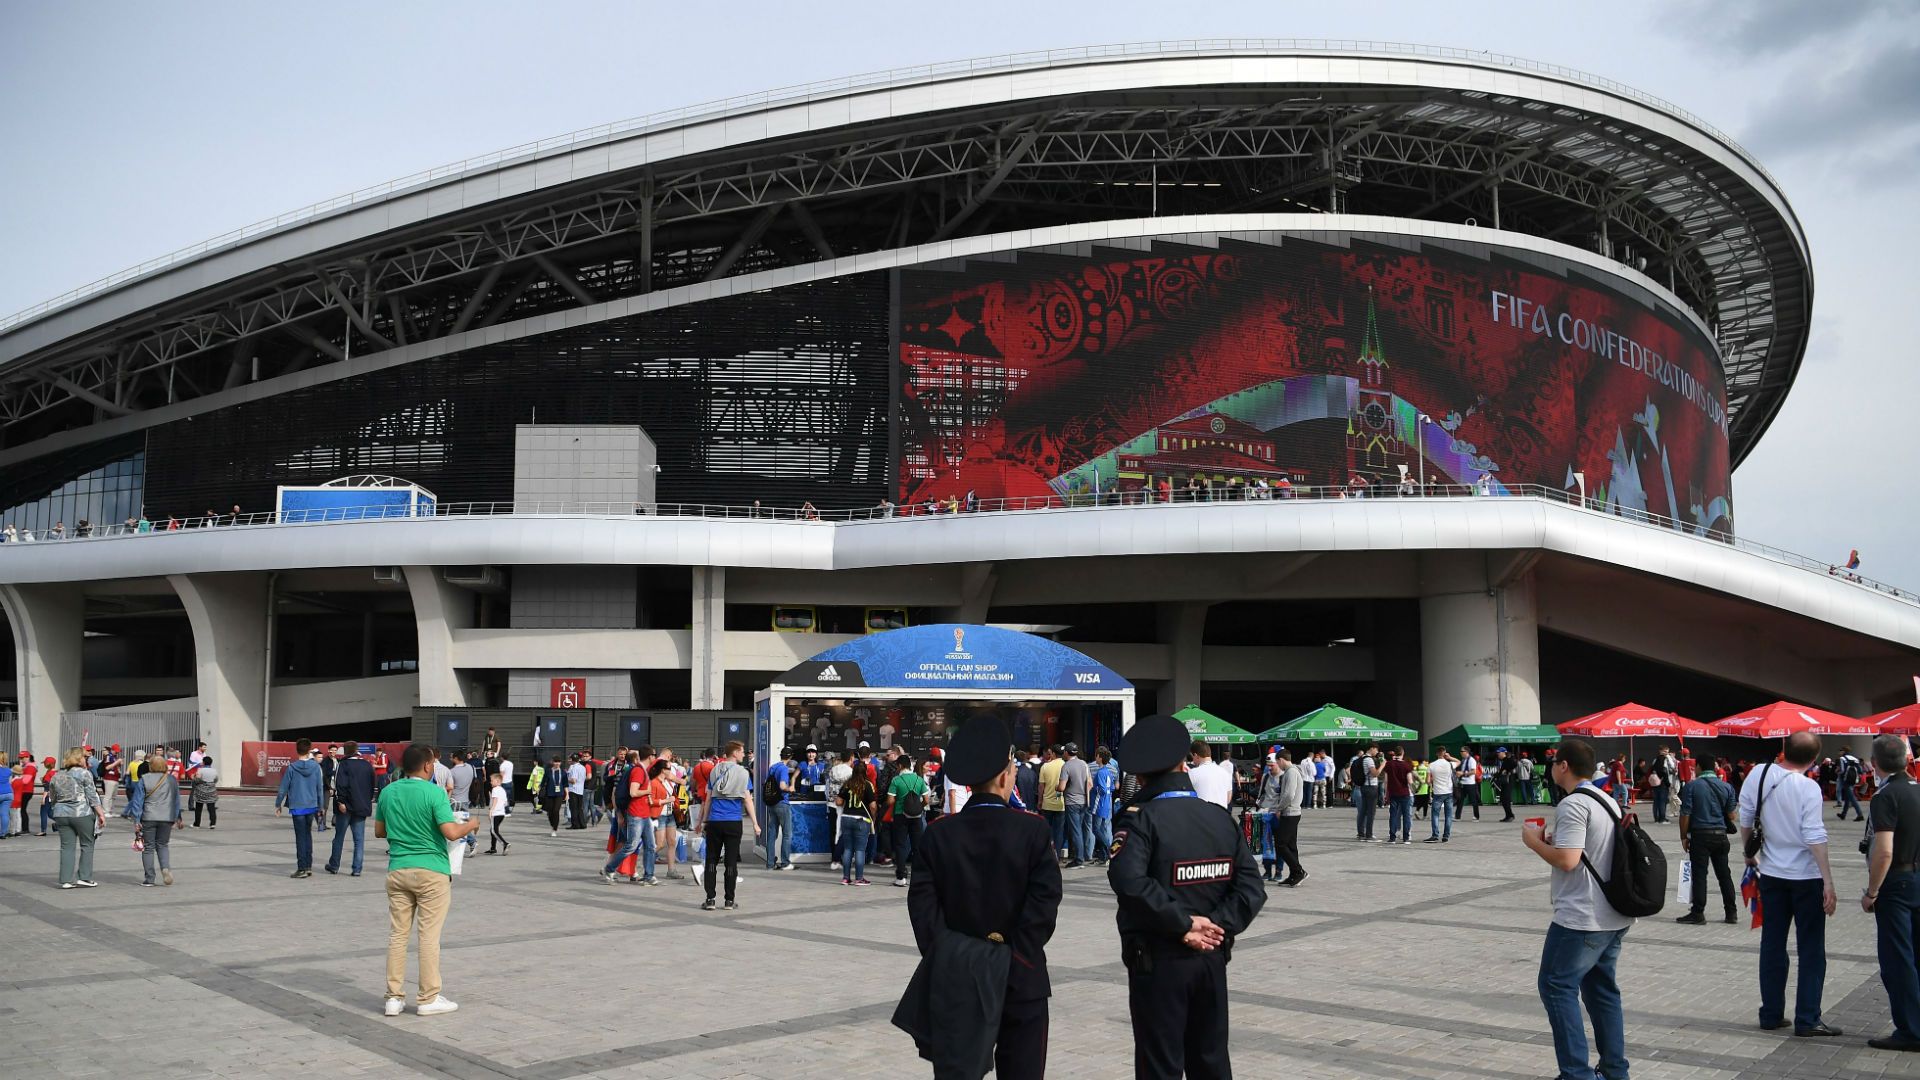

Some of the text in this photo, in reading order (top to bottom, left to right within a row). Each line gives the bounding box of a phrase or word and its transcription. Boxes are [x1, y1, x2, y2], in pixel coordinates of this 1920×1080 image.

[1491, 290, 1552, 338] FIFA
[1557, 312, 1706, 412] CONFEDERATIONS
[919, 663, 998, 672] OFFICIAL FAN SHOP
[904, 671, 1014, 681] ОФИЦИАЛЬНЫЙ МАГАЗИН
[1073, 673, 1101, 683] VISA
[267, 759, 291, 767] RUSSIA
[1177, 863, 1230, 880] ПОЛИЦИЯ
[1682, 861, 1691, 883] VISA
